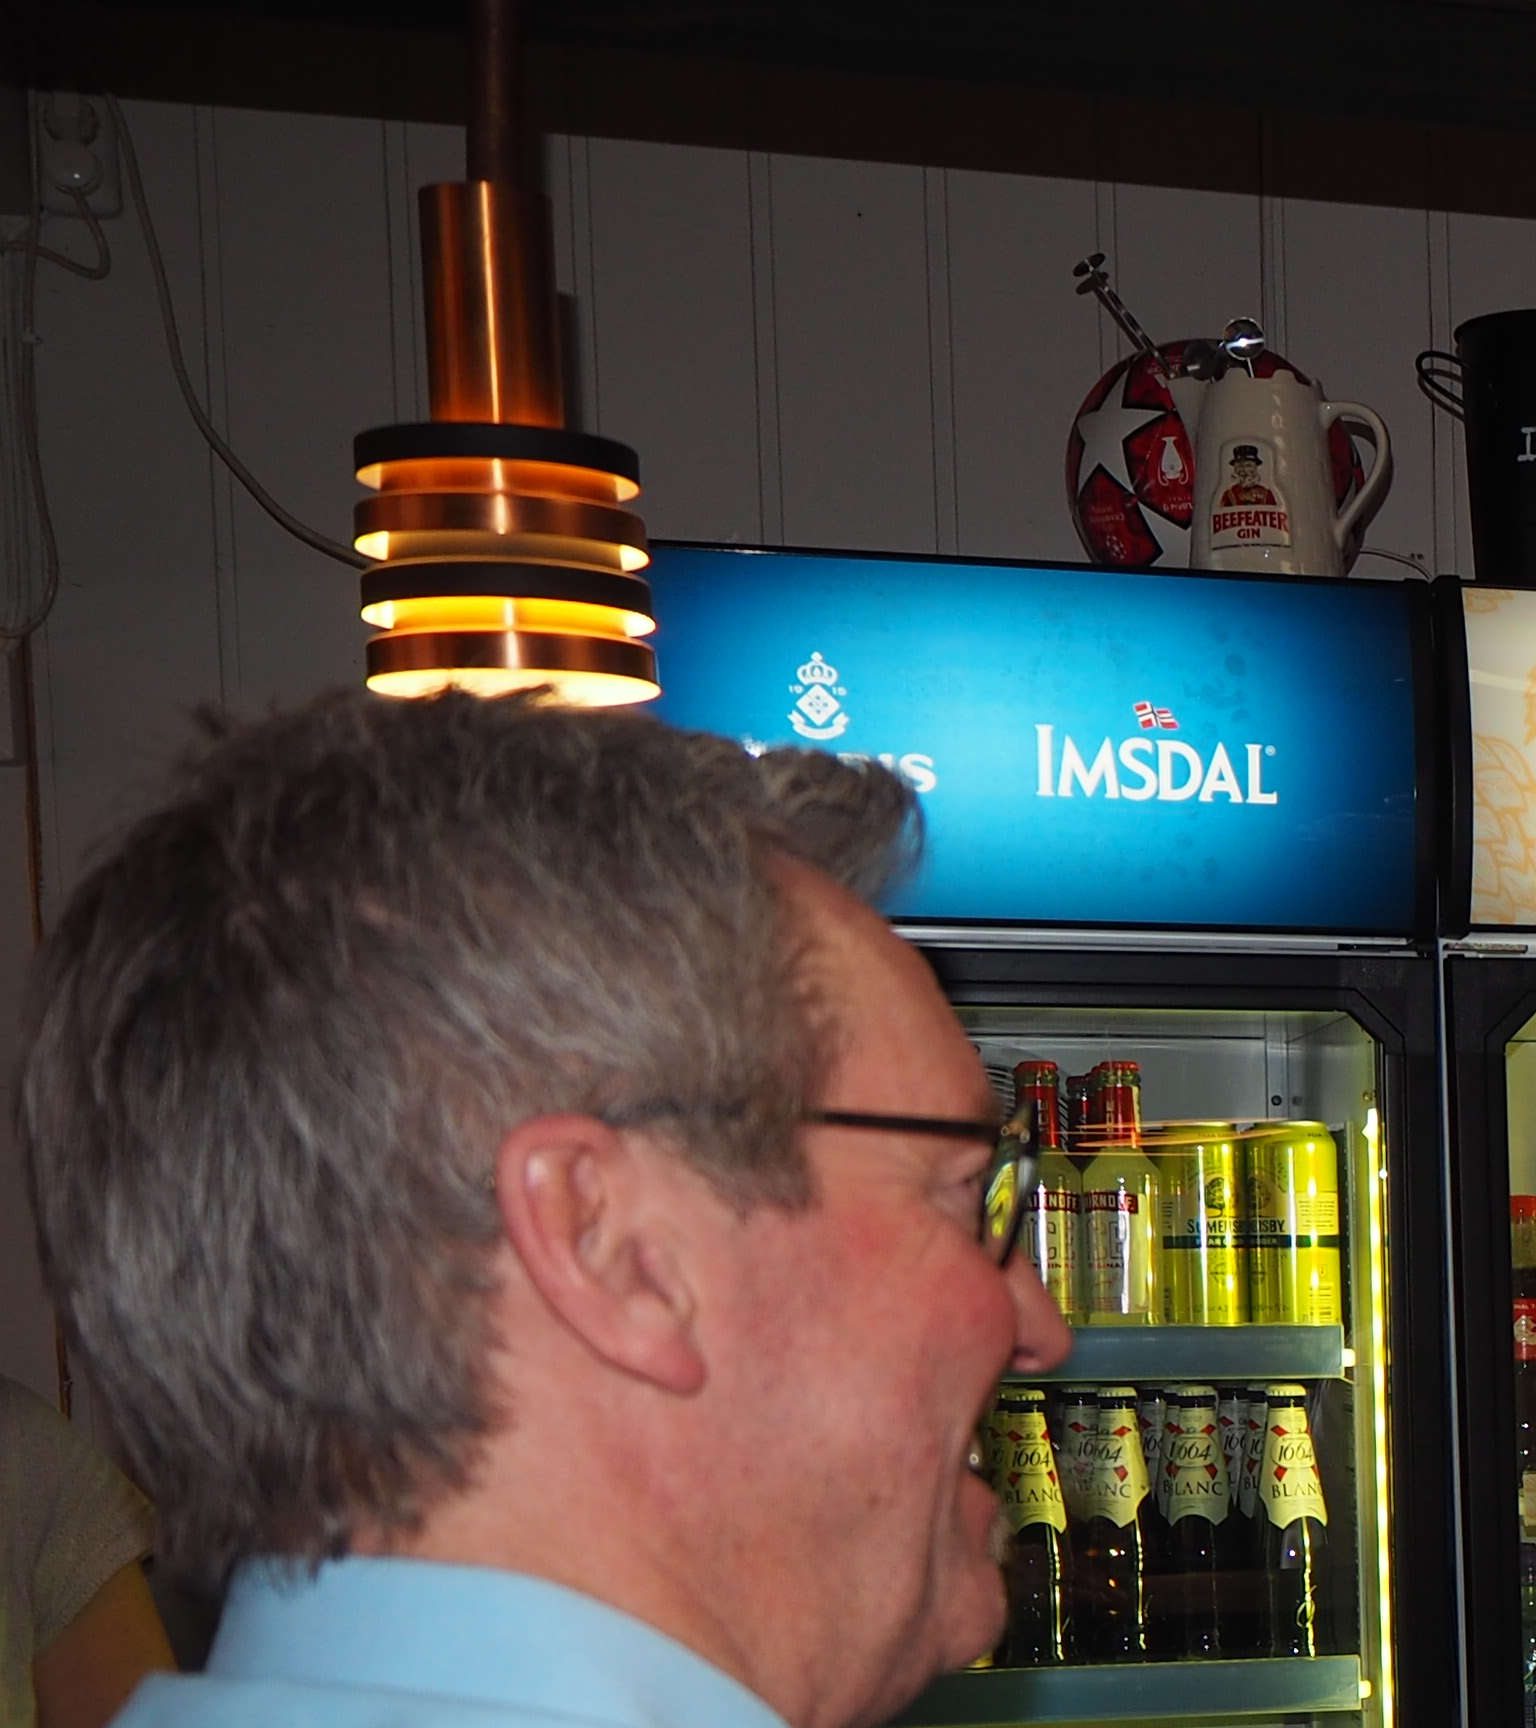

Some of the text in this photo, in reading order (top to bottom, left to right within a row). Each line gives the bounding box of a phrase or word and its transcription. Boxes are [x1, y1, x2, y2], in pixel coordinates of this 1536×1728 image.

[1213, 511, 1289, 533] BEEFEATER
[1237, 528, 1261, 539] GIN
[1036, 723, 1277, 804] IMSDAL
